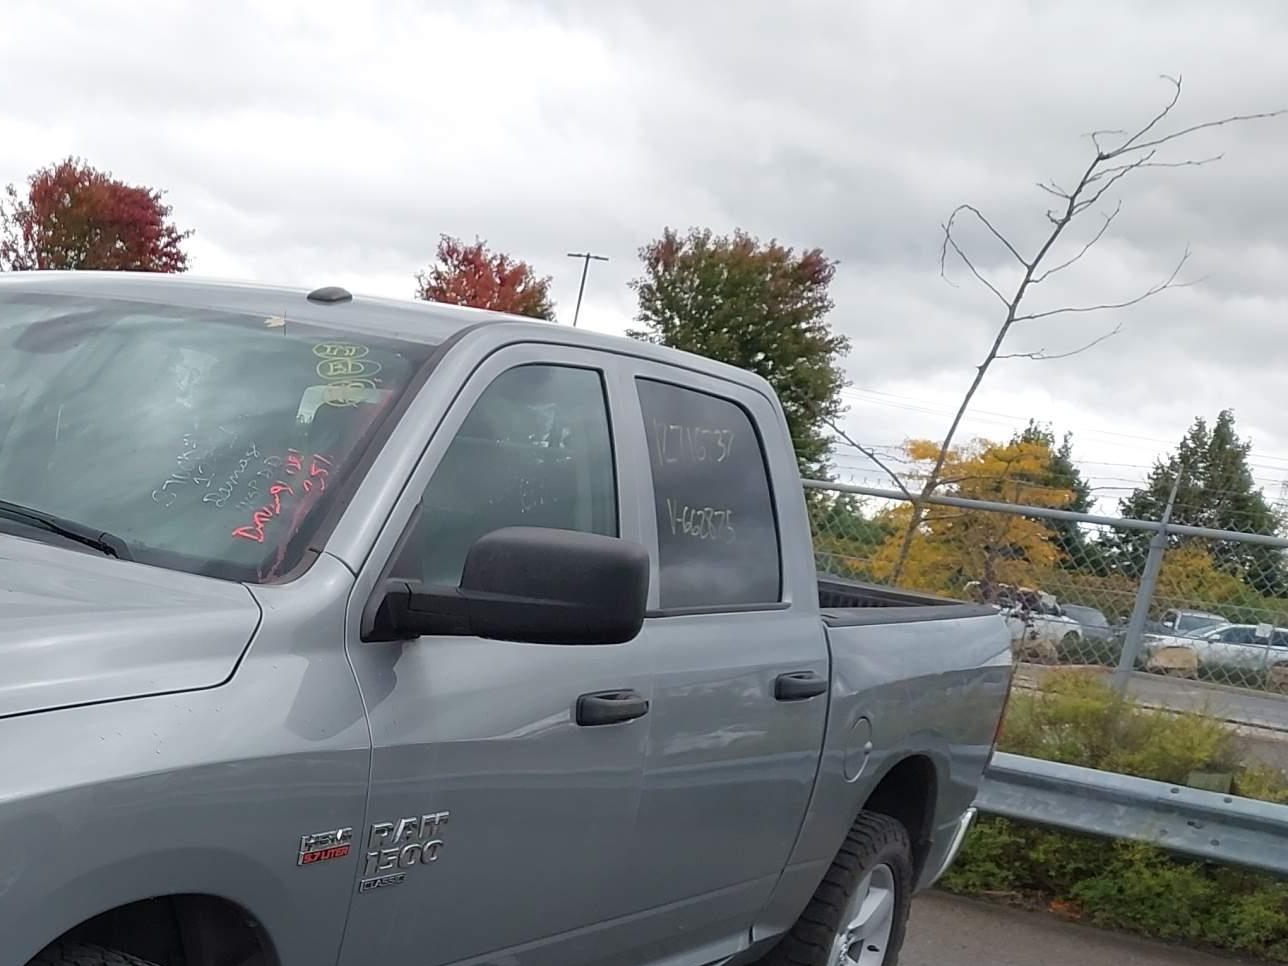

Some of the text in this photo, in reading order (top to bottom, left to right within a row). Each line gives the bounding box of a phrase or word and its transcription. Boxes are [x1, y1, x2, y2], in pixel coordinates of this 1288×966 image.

[368, 811, 450, 849] RAM
[320, 846, 349, 860] LITER
[364, 839, 444, 876] 1500
